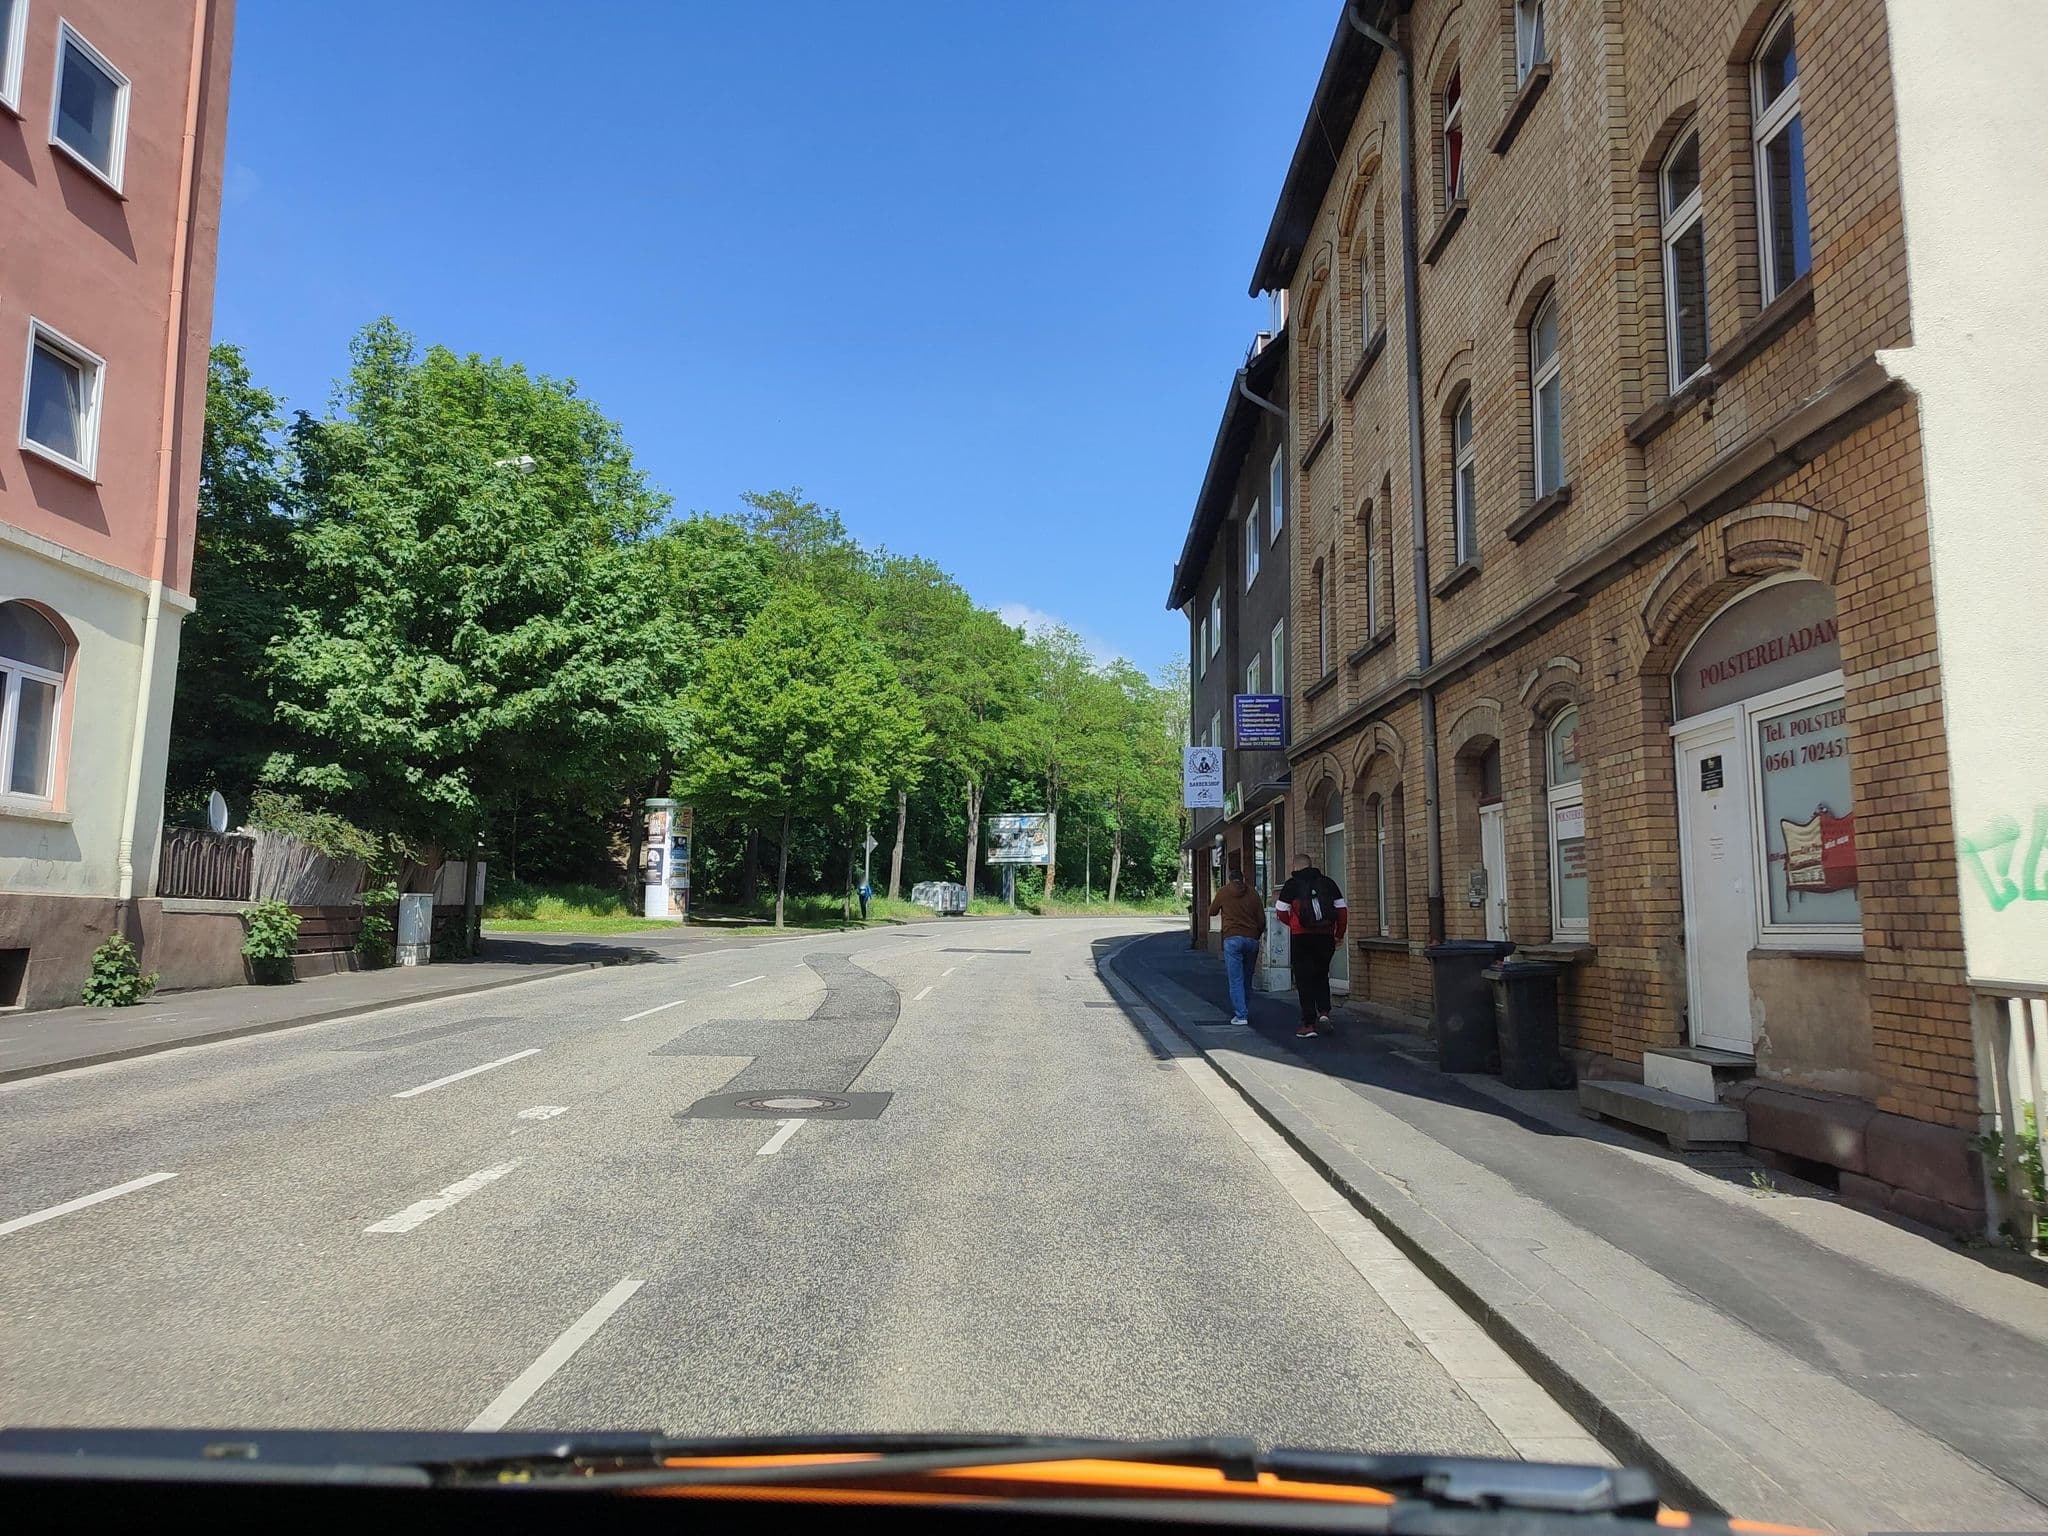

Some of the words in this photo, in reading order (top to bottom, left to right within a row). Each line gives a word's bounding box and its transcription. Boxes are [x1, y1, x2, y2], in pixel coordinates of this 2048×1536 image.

[1699, 636, 1785, 690] POLSTEREI
[1763, 722, 1786, 743] Tel.
[1765, 749, 1797, 772] 0561
